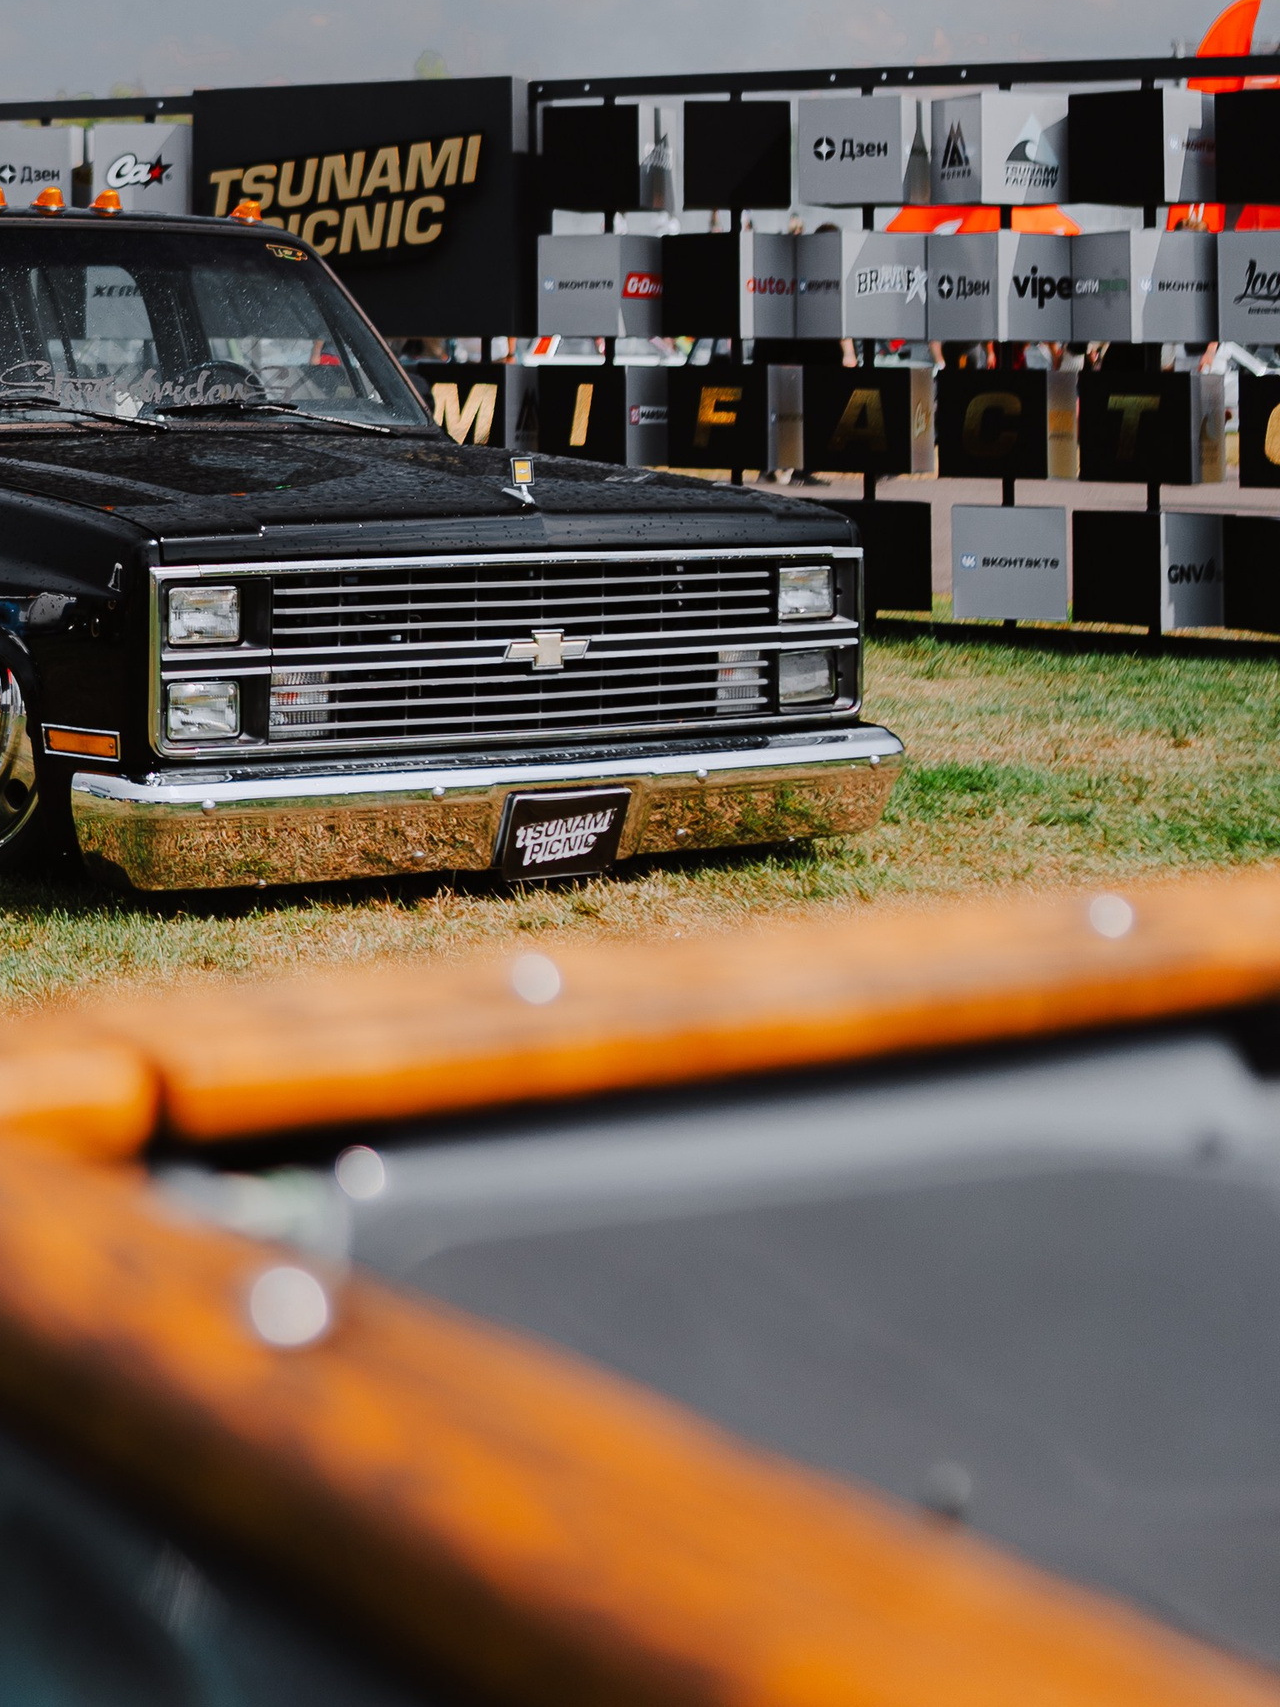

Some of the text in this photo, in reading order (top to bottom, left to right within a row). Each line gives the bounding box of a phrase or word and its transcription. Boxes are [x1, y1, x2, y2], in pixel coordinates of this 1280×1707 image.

[840, 138, 888, 161] Дзен
[21, 166, 61, 184] Дзен
[210, 135, 481, 217] TSUNAMI
[1005, 164, 1059, 179] TSUNAMI
[1005, 175, 1058, 189] FACTORY
[956, 275, 990, 300] Дзен
[516, 807, 618, 849] TSUNAMI
[522, 832, 598, 866] PICNIC
